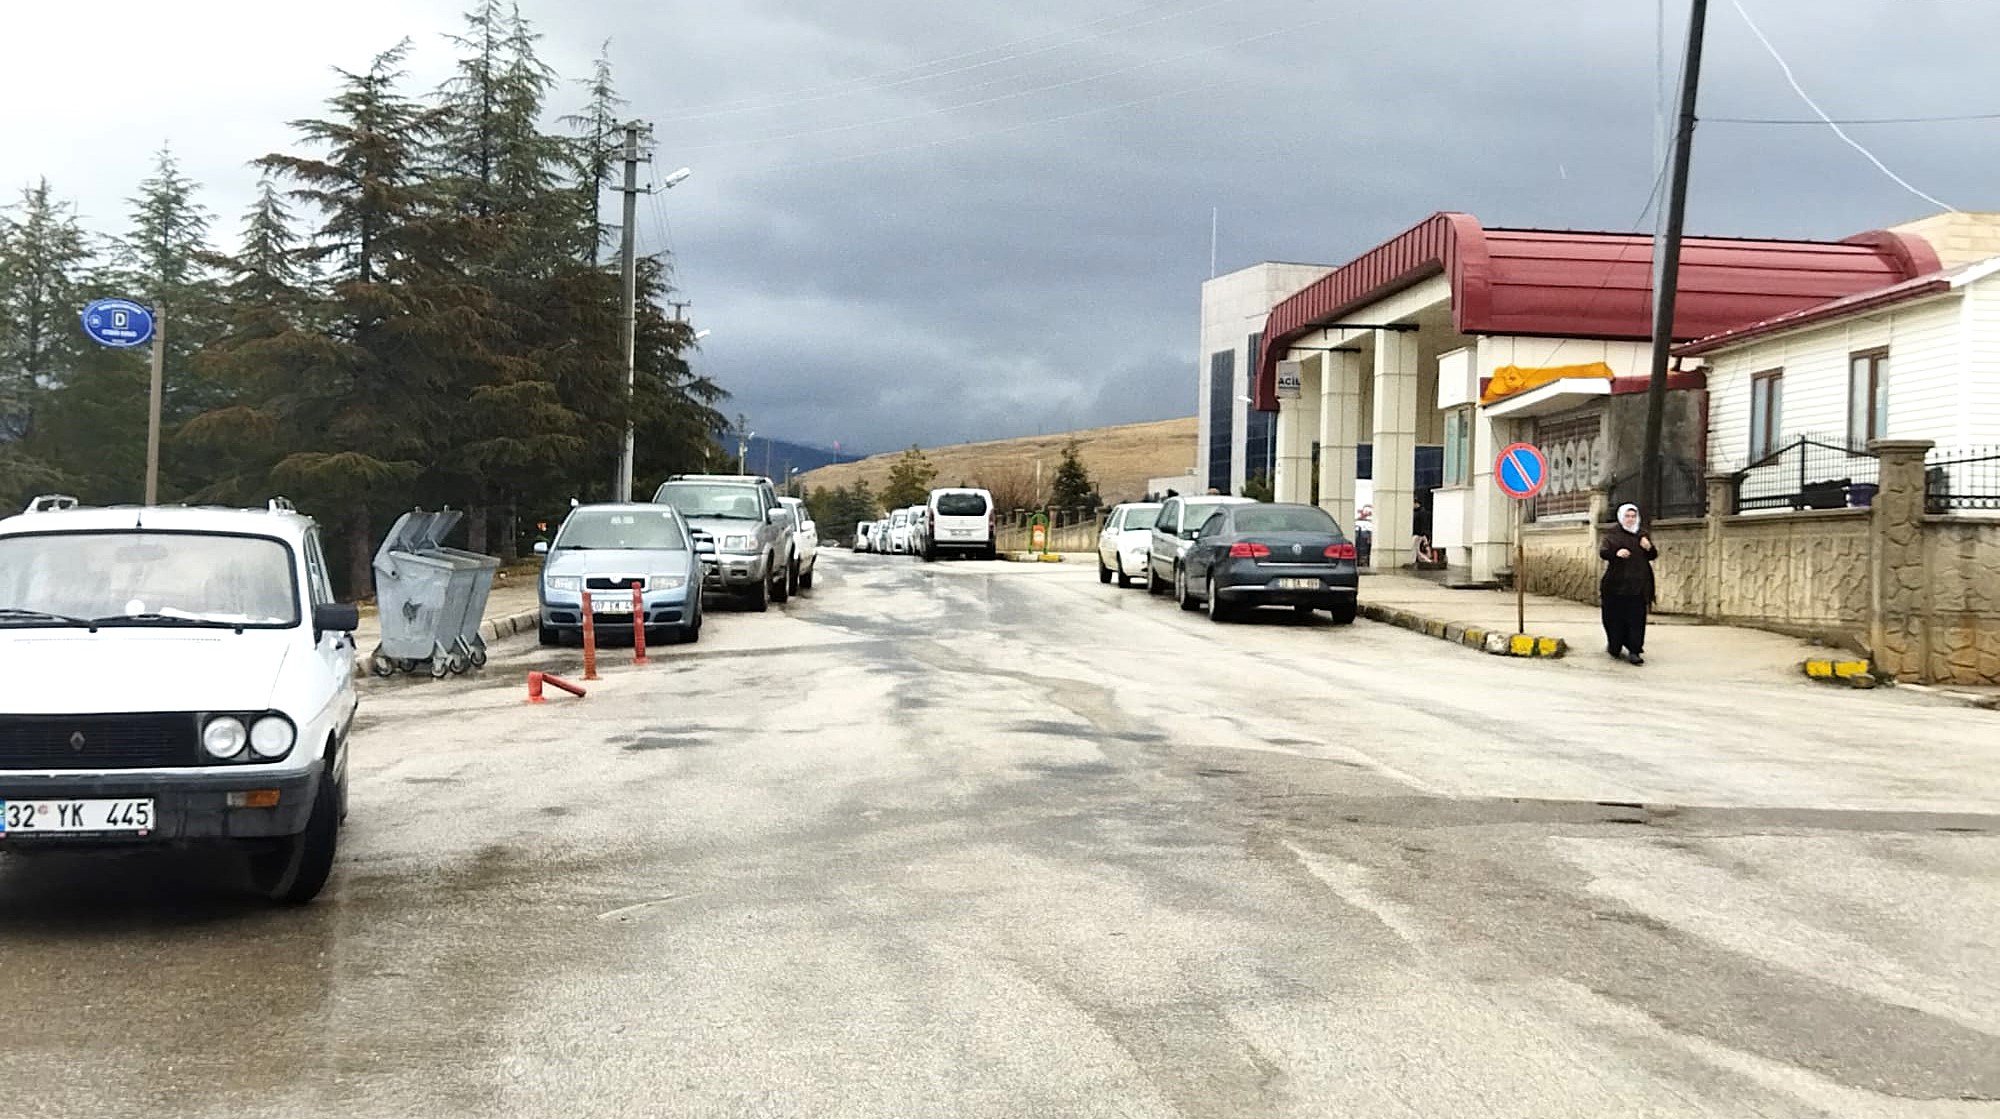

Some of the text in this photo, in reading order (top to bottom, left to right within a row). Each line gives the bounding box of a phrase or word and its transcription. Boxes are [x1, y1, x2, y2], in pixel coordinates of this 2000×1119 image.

[115, 313, 125, 326] D
[8, 802, 149, 828] 32 YK 445
